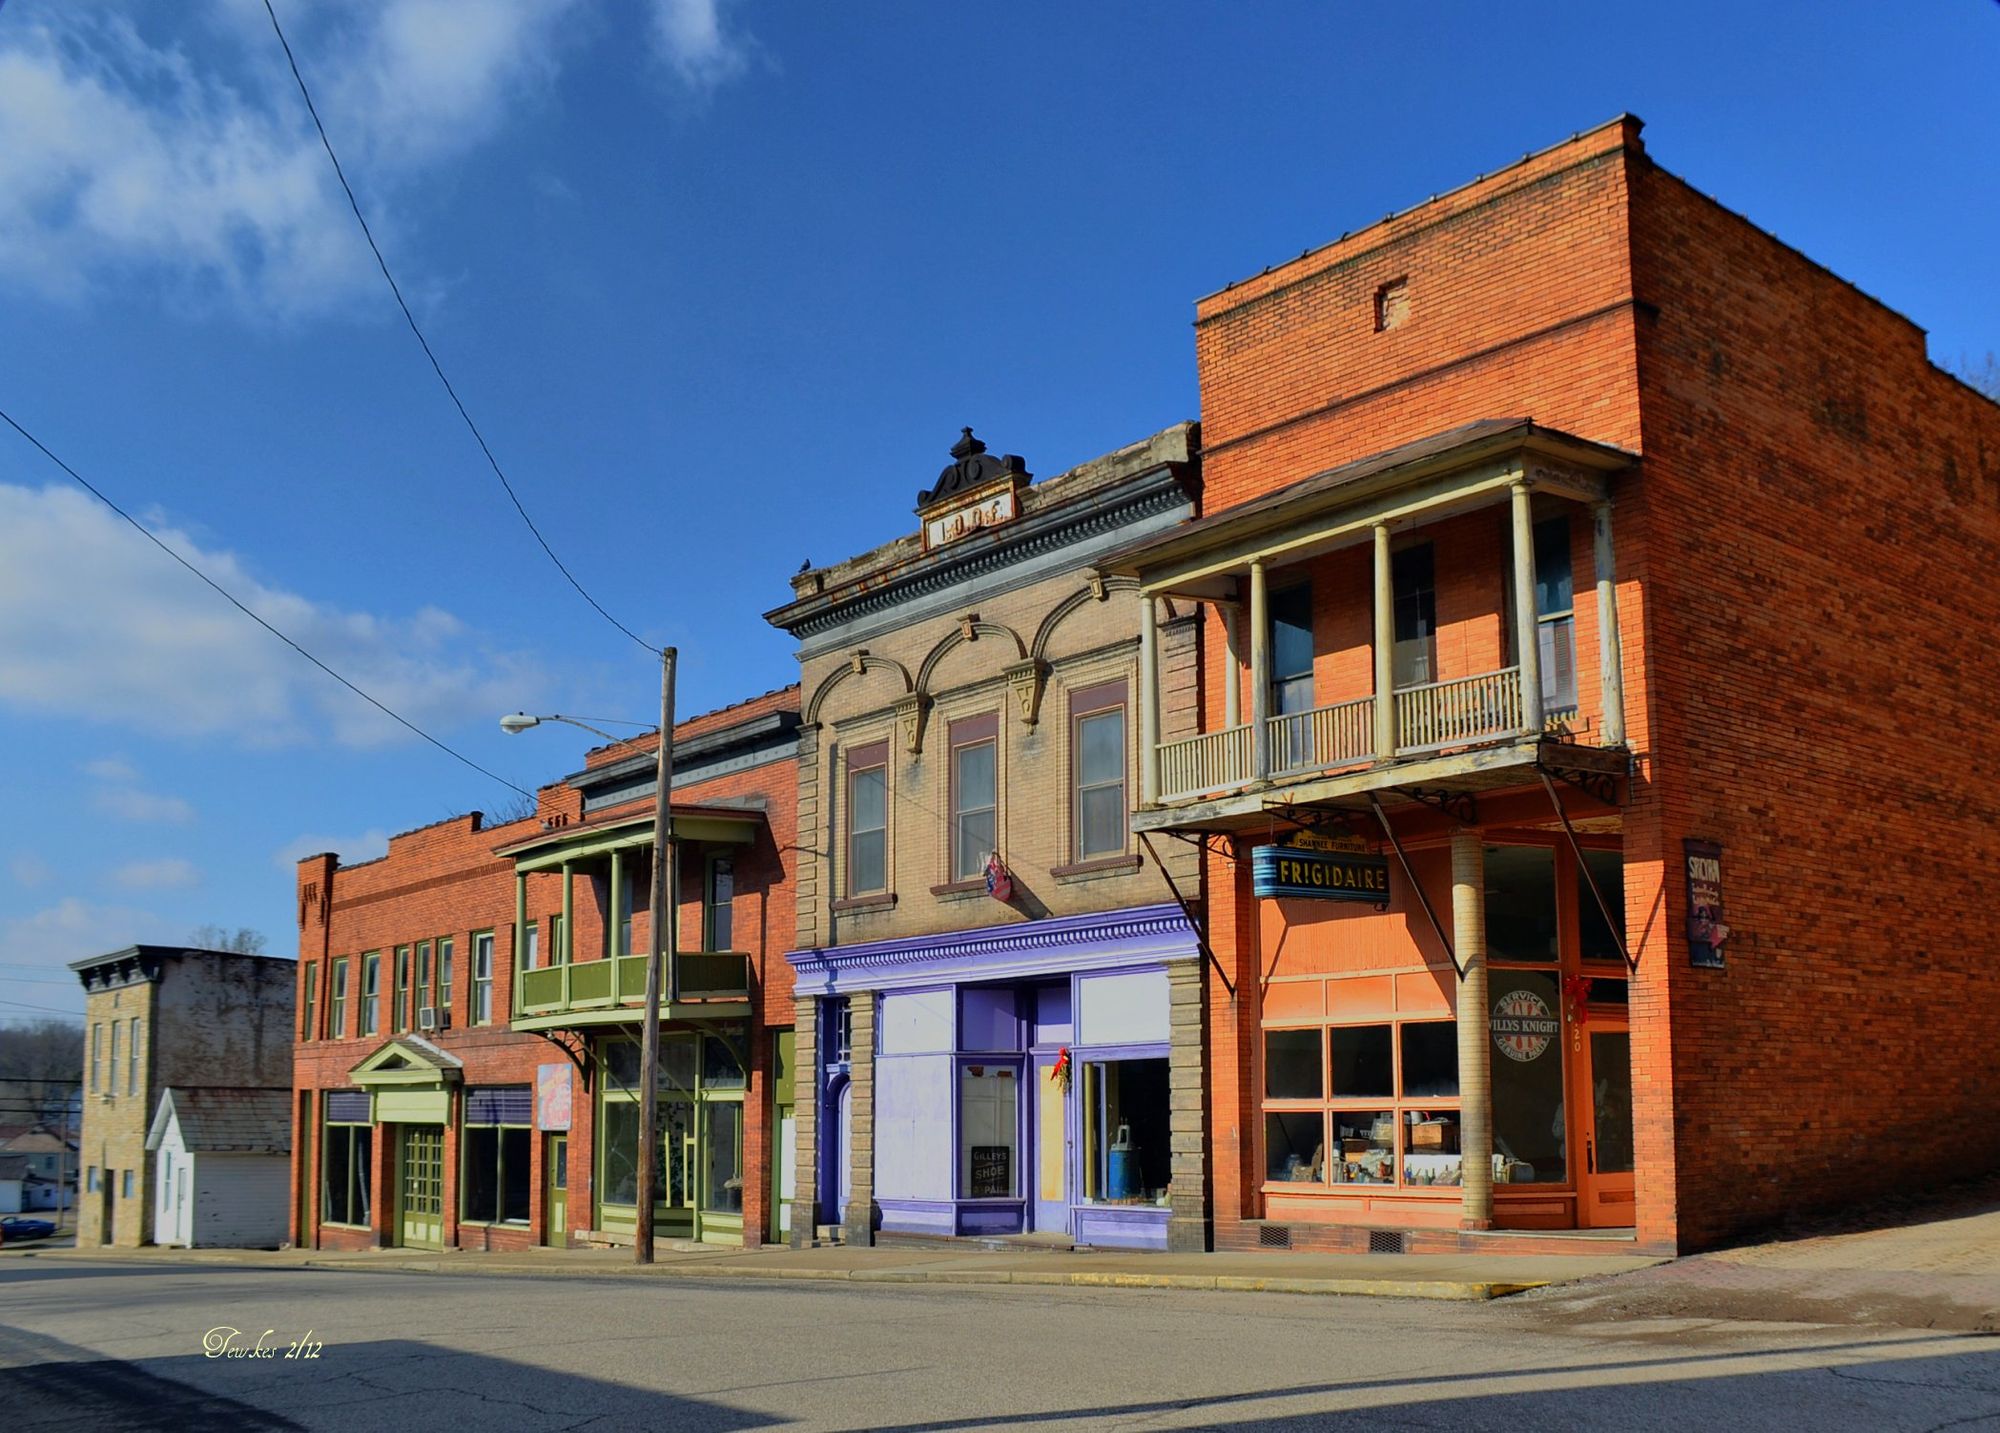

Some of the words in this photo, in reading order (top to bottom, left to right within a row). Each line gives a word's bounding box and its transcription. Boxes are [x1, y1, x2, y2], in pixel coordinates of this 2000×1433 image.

[1280, 860, 1386, 889] FRIGIDAIRE
[1499, 991, 1543, 1009] SERVICE
[1522, 1020, 1559, 1033] KNIGHT
[975, 1165, 1005, 1180] SHOE
